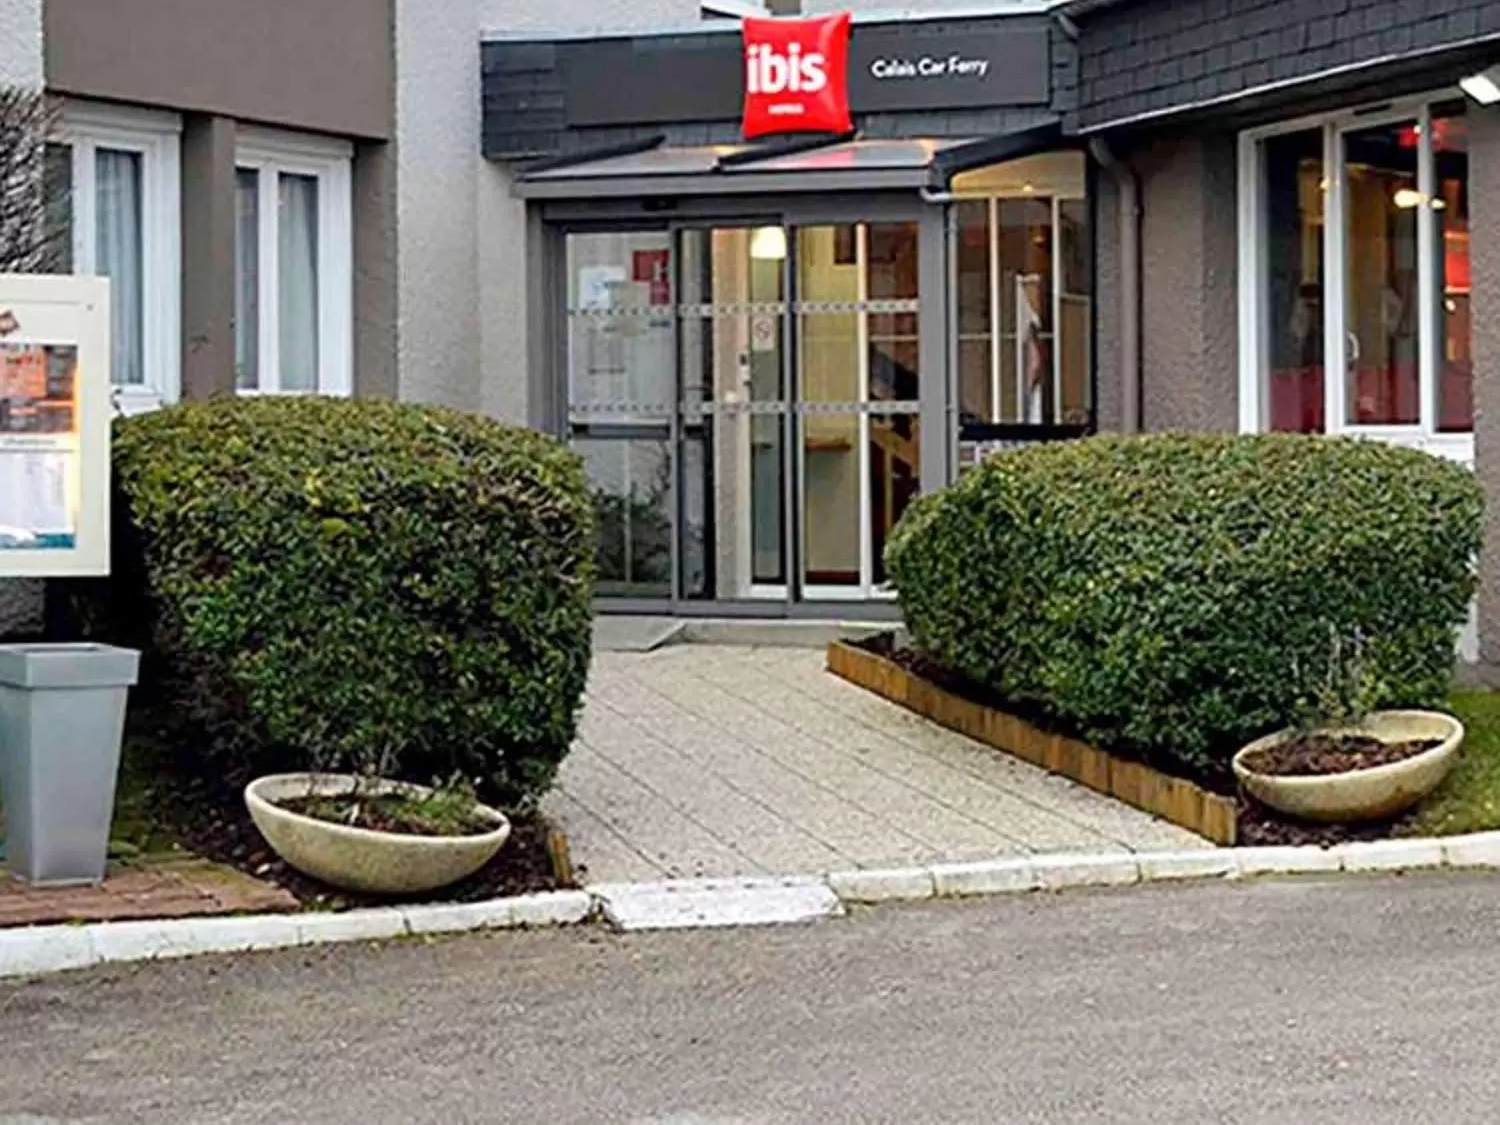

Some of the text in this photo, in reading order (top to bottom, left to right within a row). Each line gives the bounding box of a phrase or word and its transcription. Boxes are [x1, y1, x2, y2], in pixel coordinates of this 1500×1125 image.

[747, 42, 827, 93] ibis
[871, 55, 989, 78] Calais Car Ferry
